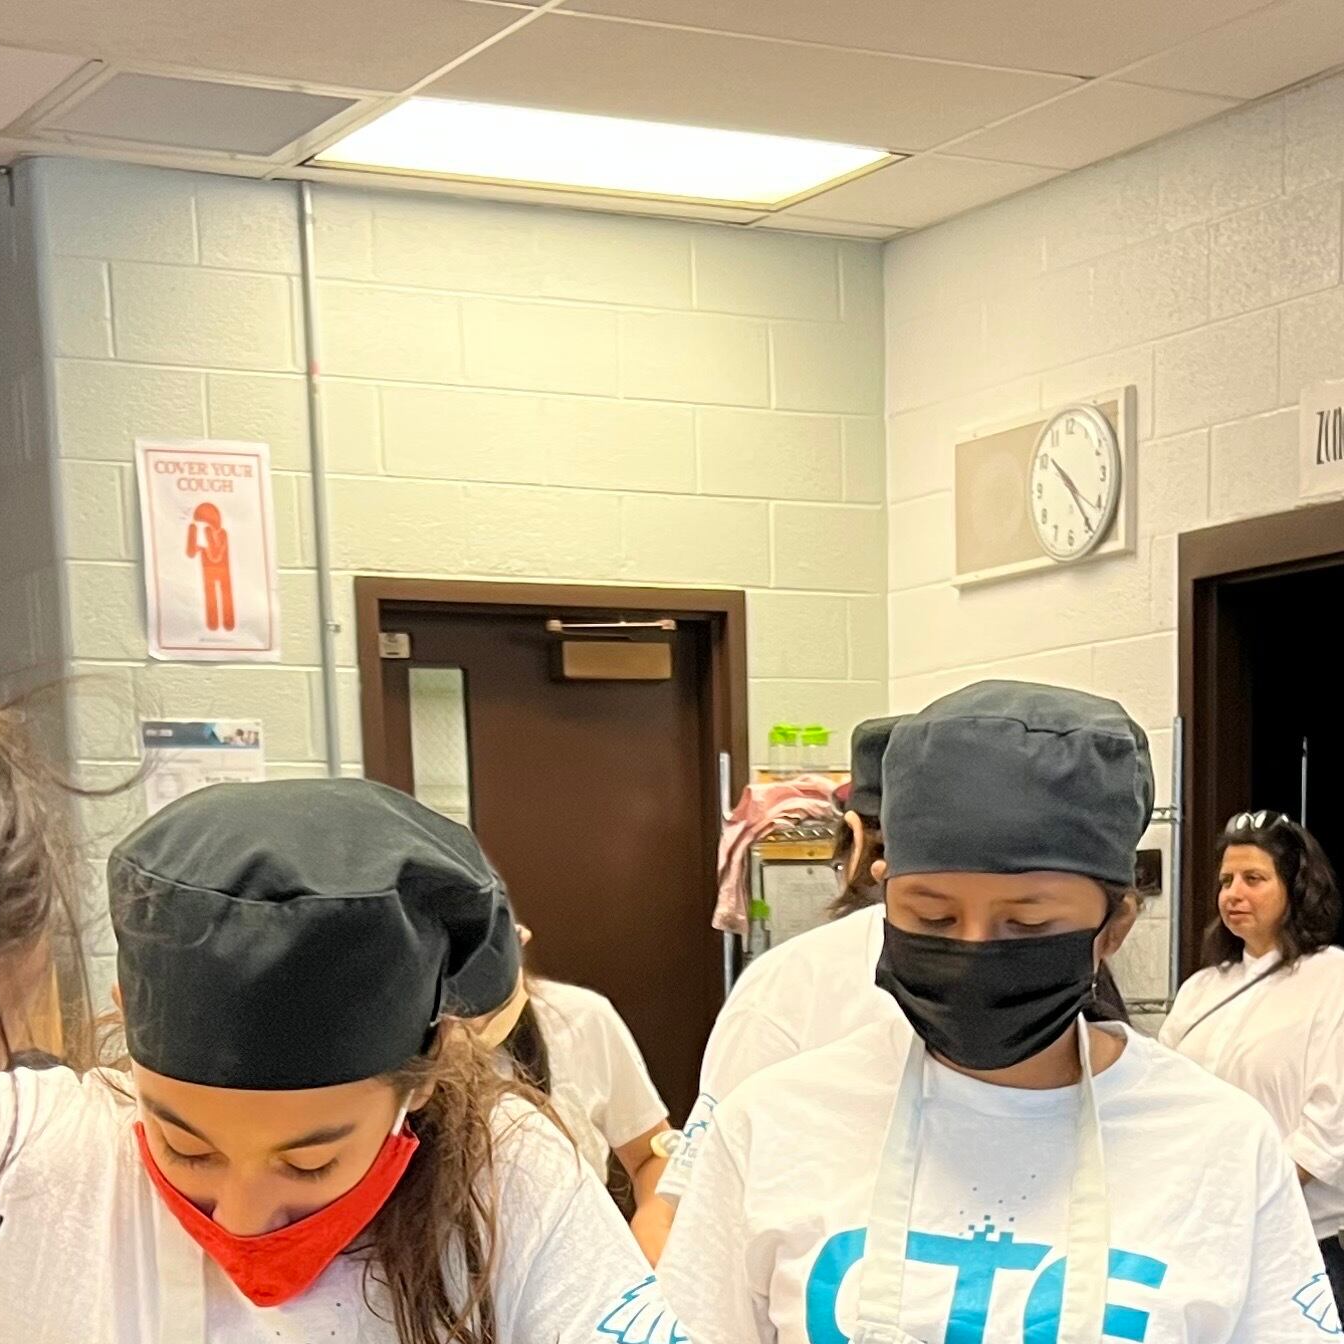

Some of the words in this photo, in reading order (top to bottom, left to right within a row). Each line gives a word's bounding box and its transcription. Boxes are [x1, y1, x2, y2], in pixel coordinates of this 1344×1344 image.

[154, 460, 208, 477] COVER
[211, 462, 254, 479] YOUR
[177, 477, 234, 493] COUGH
